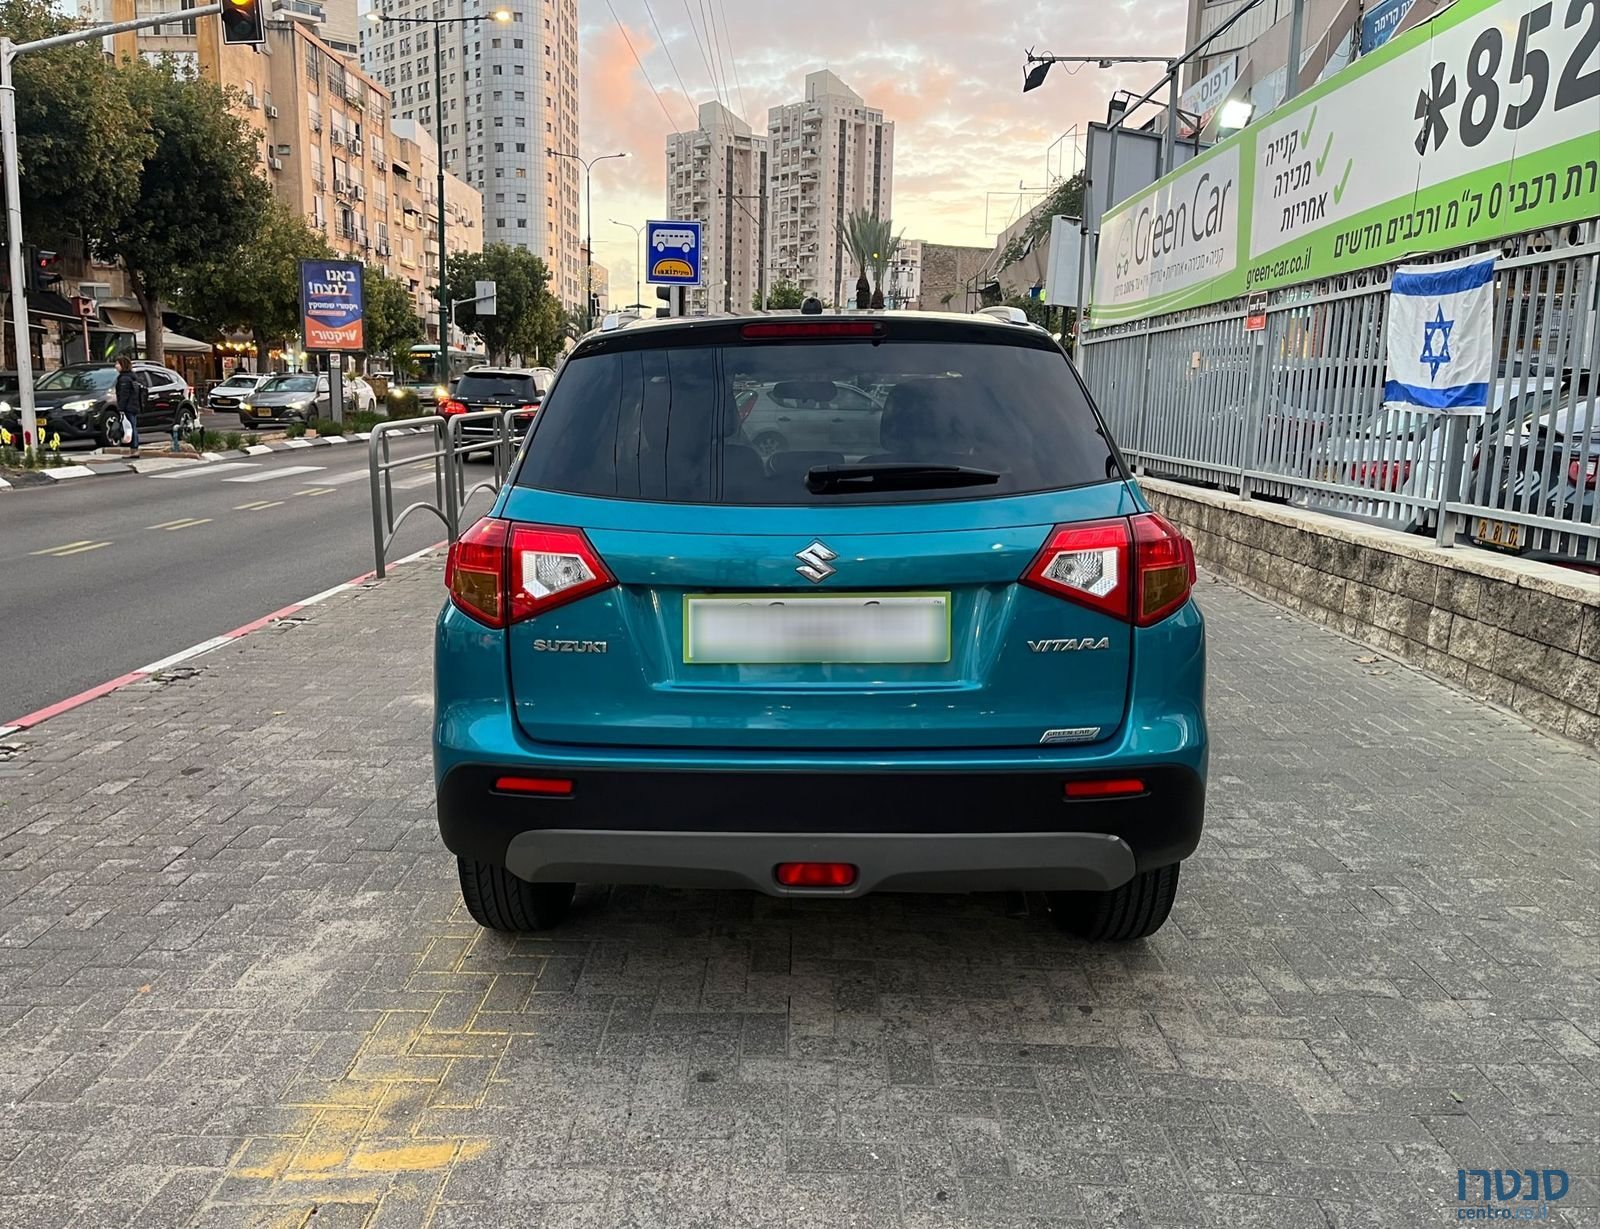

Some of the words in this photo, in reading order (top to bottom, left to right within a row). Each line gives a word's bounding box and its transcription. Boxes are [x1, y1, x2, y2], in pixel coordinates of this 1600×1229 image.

[1374, 7, 1399, 33] קדימה
[1201, 65, 1230, 102] דפוס
[1265, 130, 1299, 167] קנייה
[1273, 160, 1311, 199] מכירה
[1508, 172, 1557, 213] רכבי
[1135, 202, 1186, 265] Green
[1191, 172, 1232, 241] Car
[1280, 192, 1328, 232] אחריות
[1488, 182, 1503, 219] 0
[1333, 222, 1383, 258] חדשים
[1386, 204, 1441, 244] ורכבים
[325, 269, 356, 281] באנו
[1245, 246, 1312, 290] green-car.co.il
[308, 281, 347, 295] לנצח!
[533, 639, 607, 653] SUZUKI
[1027, 637, 1109, 652] VITARA
